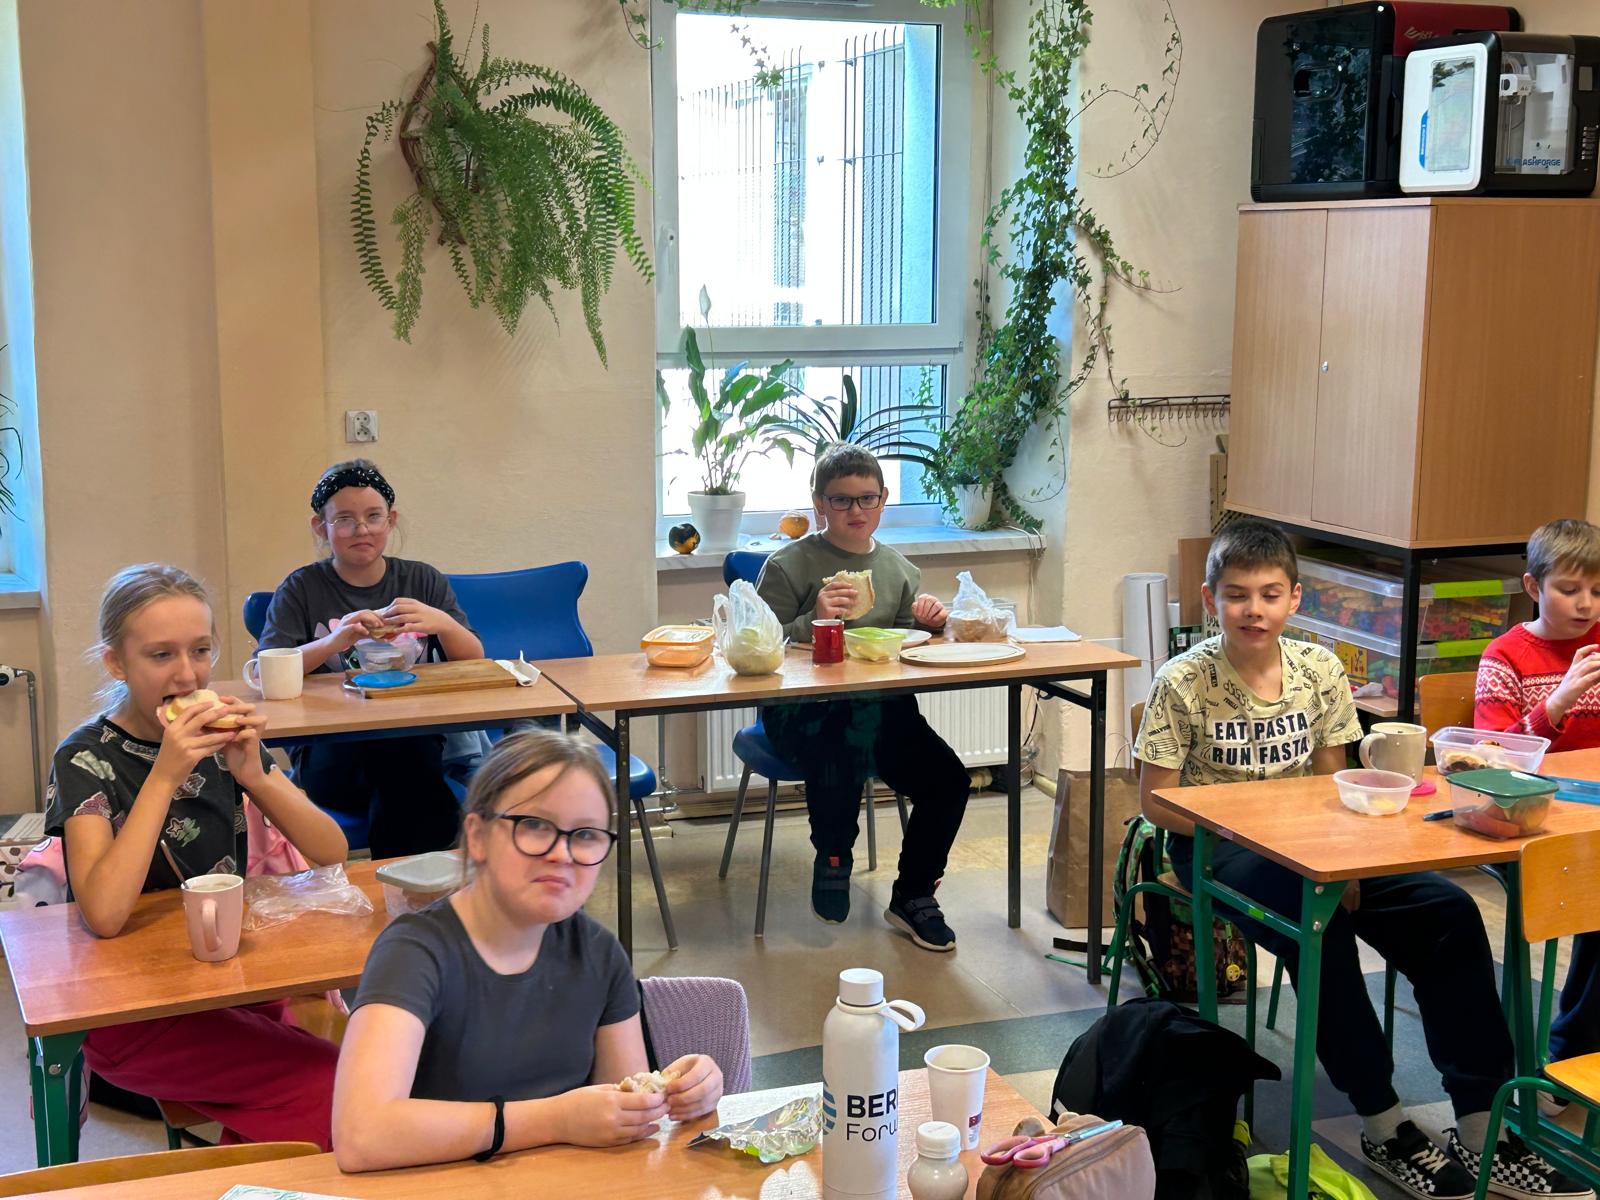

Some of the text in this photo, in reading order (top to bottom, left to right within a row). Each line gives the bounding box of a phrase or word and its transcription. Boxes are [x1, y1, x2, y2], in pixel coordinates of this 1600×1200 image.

[1513, 158, 1561, 167] ASHFORGE
[1214, 722, 1248, 741] EAT
[1254, 712, 1309, 741] PASTA
[1212, 736, 1309, 766] RUN FASTA
[847, 1084, 898, 1119] BER
